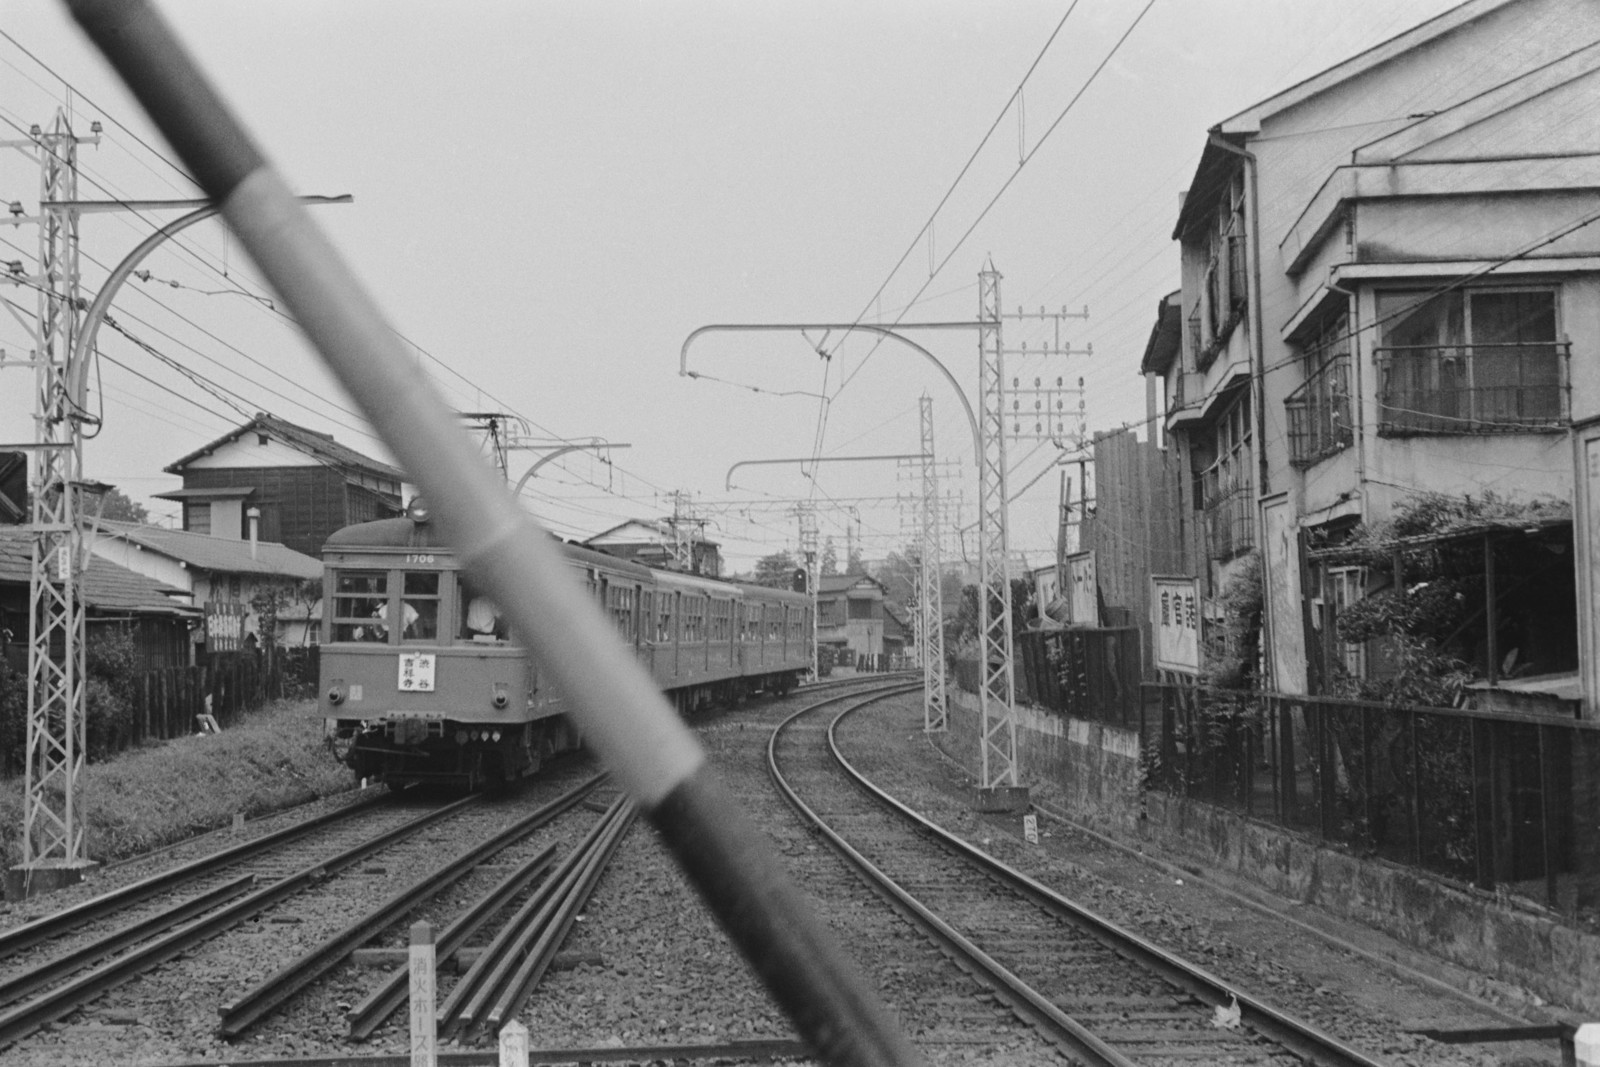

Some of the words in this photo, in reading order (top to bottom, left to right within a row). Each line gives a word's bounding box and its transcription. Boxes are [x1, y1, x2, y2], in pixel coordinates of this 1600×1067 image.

[406, 554, 435, 563] 1706
[403, 658, 415, 688] 吉祥寺
[419, 658, 430, 689] 渋谷
